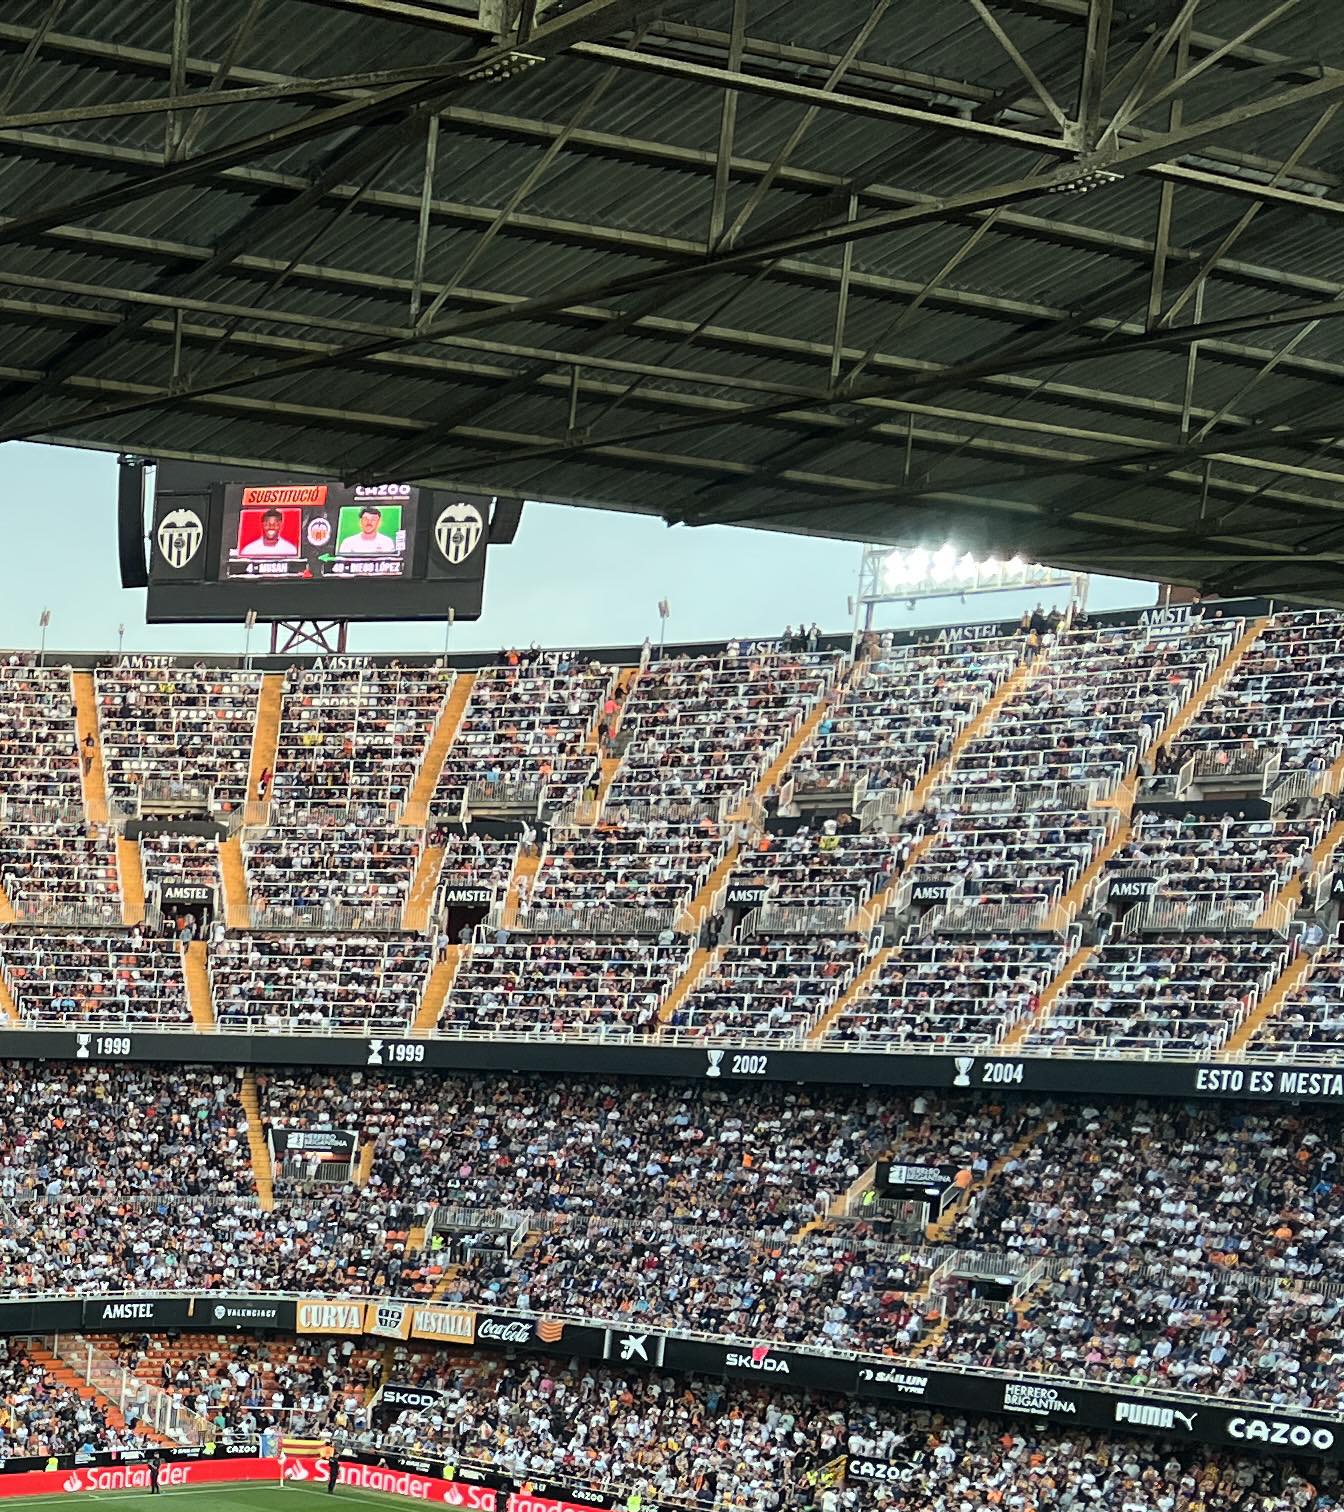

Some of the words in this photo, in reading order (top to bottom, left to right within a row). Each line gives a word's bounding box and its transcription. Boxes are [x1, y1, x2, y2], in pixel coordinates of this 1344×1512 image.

[248, 487, 319, 503] SUBSTITUCIÓ
[246, 563, 253, 572] 4
[165, 886, 208, 899] AMSTEL
[728, 890, 764, 902] AMSTE
[912, 887, 951, 899] AMST
[1110, 883, 1155, 896] AMSTE
[96, 1038, 131, 1055] 1999
[387, 1044, 424, 1063] 1999
[732, 1055, 767, 1074] 2002
[982, 1063, 1024, 1083] 2004
[1196, 1069, 1244, 1091] ESTO
[1249, 1071, 1274, 1092] ES
[102, 1303, 154, 1319] AMSTEL
[300, 1304, 360, 1329] CURVA
[414, 1311, 473, 1337] MESTALLA
[478, 1318, 532, 1343] Coca-Cola
[725, 1352, 790, 1374] SKODA
[875, 1371, 928, 1387] SAILUN
[383, 1391, 434, 1406] SKOD
[1005, 1383, 1058, 1400] HERRERO
[1004, 1393, 1076, 1414] BRIGANTINA
[1115, 1402, 1175, 1429] PUMA
[1228, 1417, 1334, 1450] CAZOO
[225, 1445, 256, 1454] CAZOO
[572, 1489, 604, 1503] CAZOO
